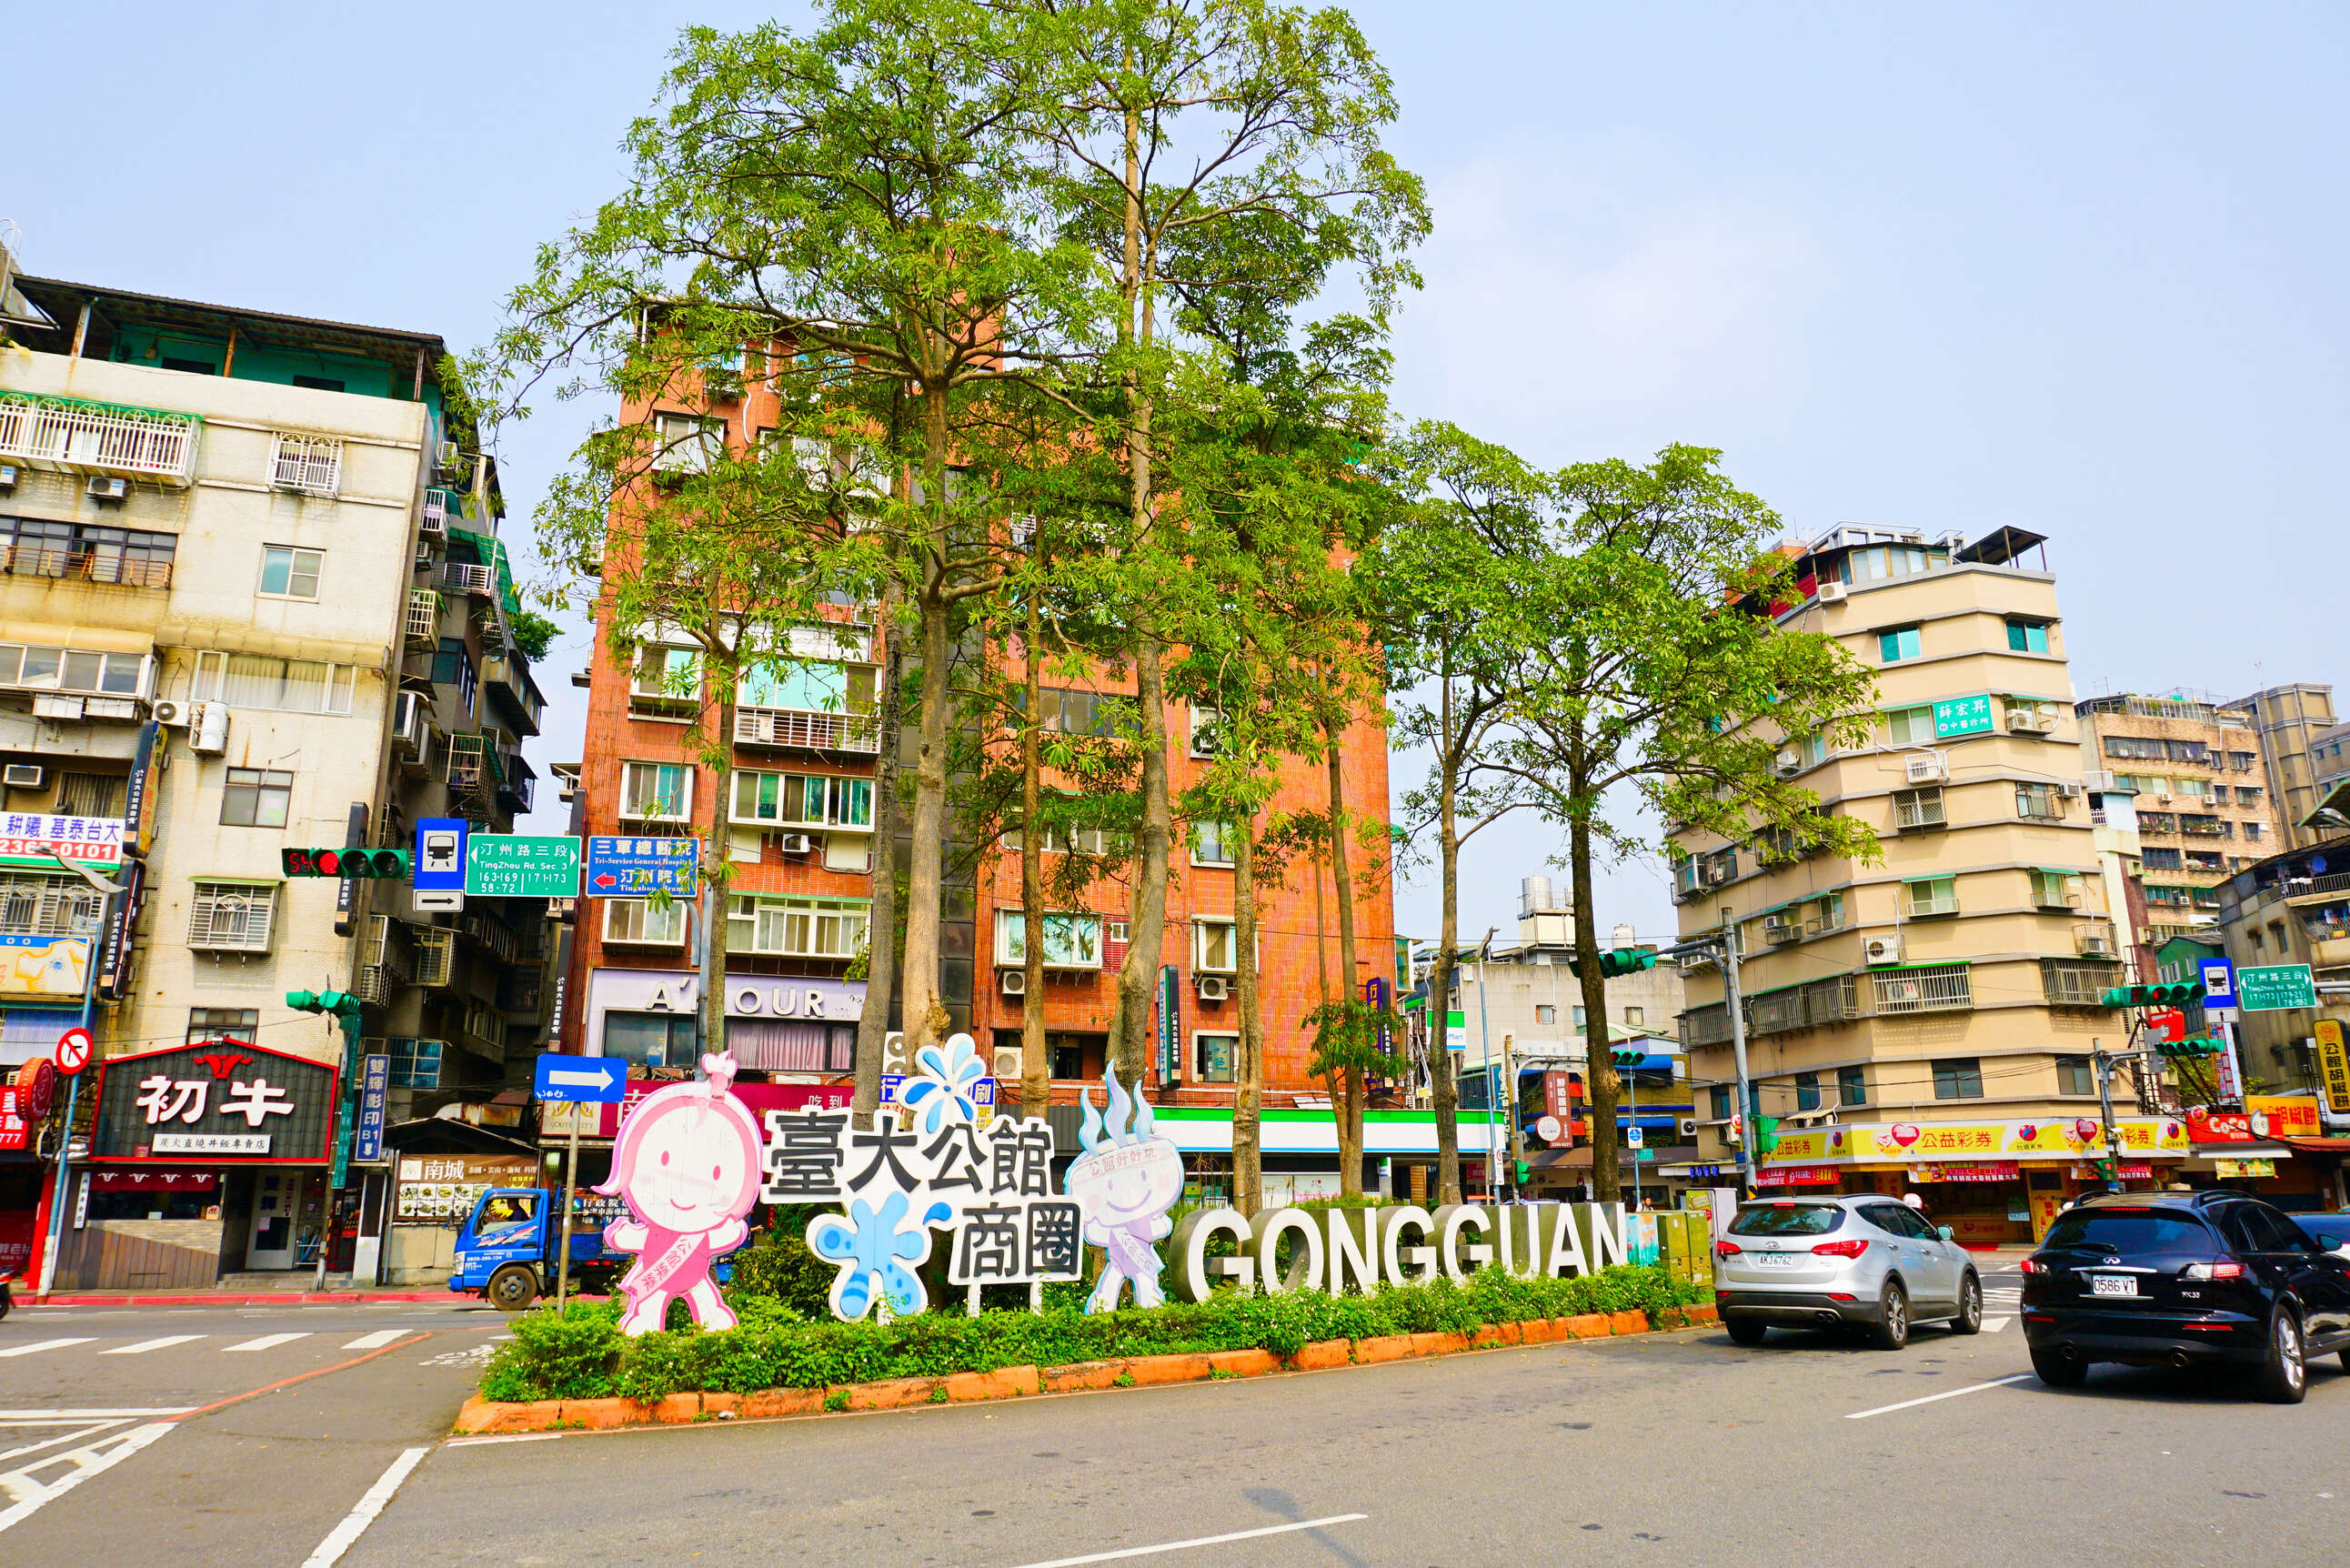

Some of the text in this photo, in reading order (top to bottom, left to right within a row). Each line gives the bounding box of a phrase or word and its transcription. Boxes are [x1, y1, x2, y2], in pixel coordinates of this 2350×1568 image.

[480, 843, 568, 857] 汀州路三段
[596, 839, 692, 856] 三軍總醫院
[479, 860, 520, 871] TingZhou
[594, 857, 633, 865] Tri-Service
[662, 858, 692, 866] Hospitl
[479, 872, 567, 883] 163-169 171-173
[481, 883, 516, 893] 58-72
[2246, 970, 2304, 983] 汀州路三段
[2324, 1042, 2350, 1108] 公館胡椒餅
[136, 1075, 295, 1127] 初牛
[363, 1059, 387, 1126] 雙輝影印
[808, 1094, 855, 1110] 吃到
[2208, 1116, 2248, 1134] CoCo
[361, 1130, 379, 1141] B1
[1922, 1131, 1993, 1150] 公益彩券
[2098, 1128, 2150, 1145] 公彩券
[768, 1110, 1053, 1197] 臺大公館
[1776, 1138, 1811, 1156] 公益彩券
[425, 1160, 466, 1181] 南城
[957, 1201, 1081, 1279] 商圈
[1185, 1201, 1630, 1301] GONGGUAN
